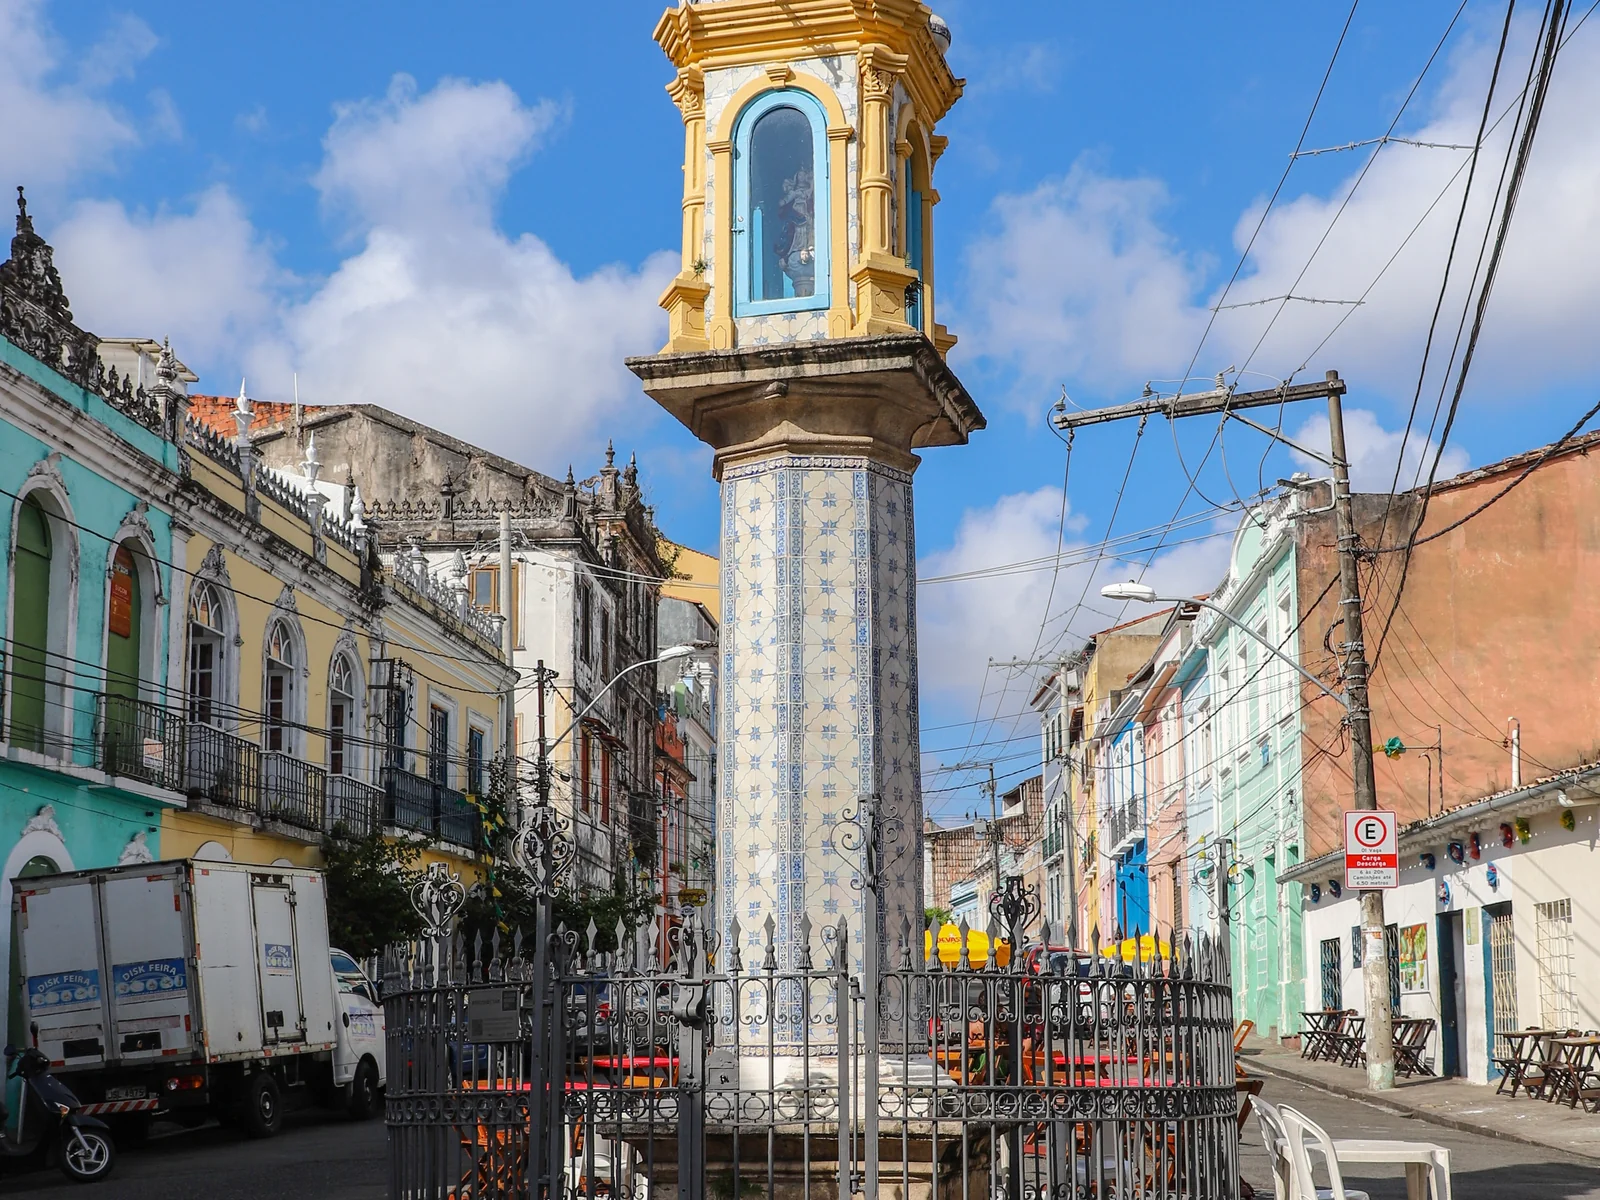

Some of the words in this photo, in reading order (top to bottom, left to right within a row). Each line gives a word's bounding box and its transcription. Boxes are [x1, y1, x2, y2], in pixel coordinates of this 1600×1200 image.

[1365, 823, 1376, 840] E
[122, 966, 145, 981] DISK
[149, 963, 177, 975] FEIRA
[37, 976, 60, 993] DISK
[63, 975, 91, 986] FEIRA
